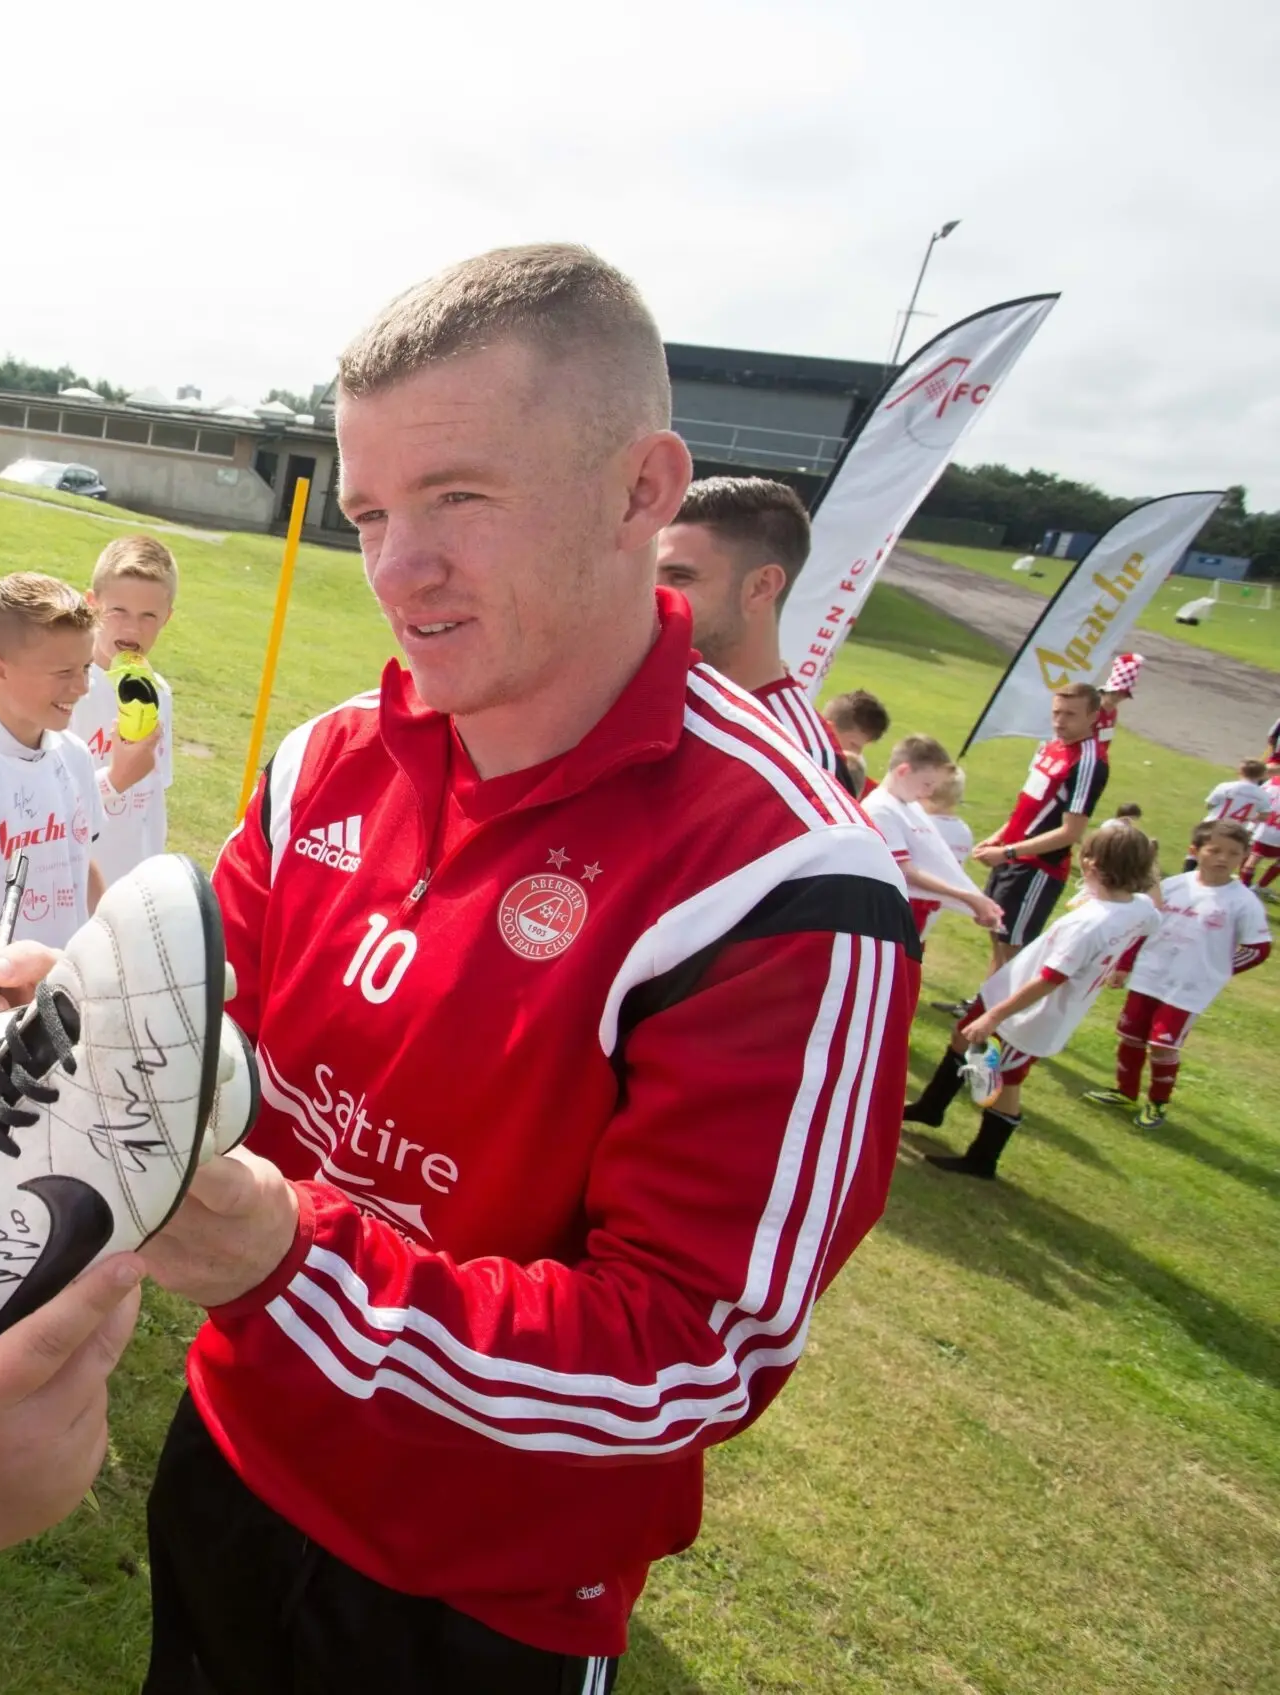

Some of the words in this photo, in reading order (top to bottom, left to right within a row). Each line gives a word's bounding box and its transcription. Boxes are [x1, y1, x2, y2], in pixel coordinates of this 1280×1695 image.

[840, 558, 867, 592] FC
[1035, 552, 1146, 690] Apache
[294, 837, 362, 873] adidas
[531, 879, 583, 910] ABERDEEN
[503, 906, 541, 956] FOOTBALL
[545, 931, 574, 954] CLUB
[527, 924, 547, 937] 1903
[342, 912, 418, 1005] 10
